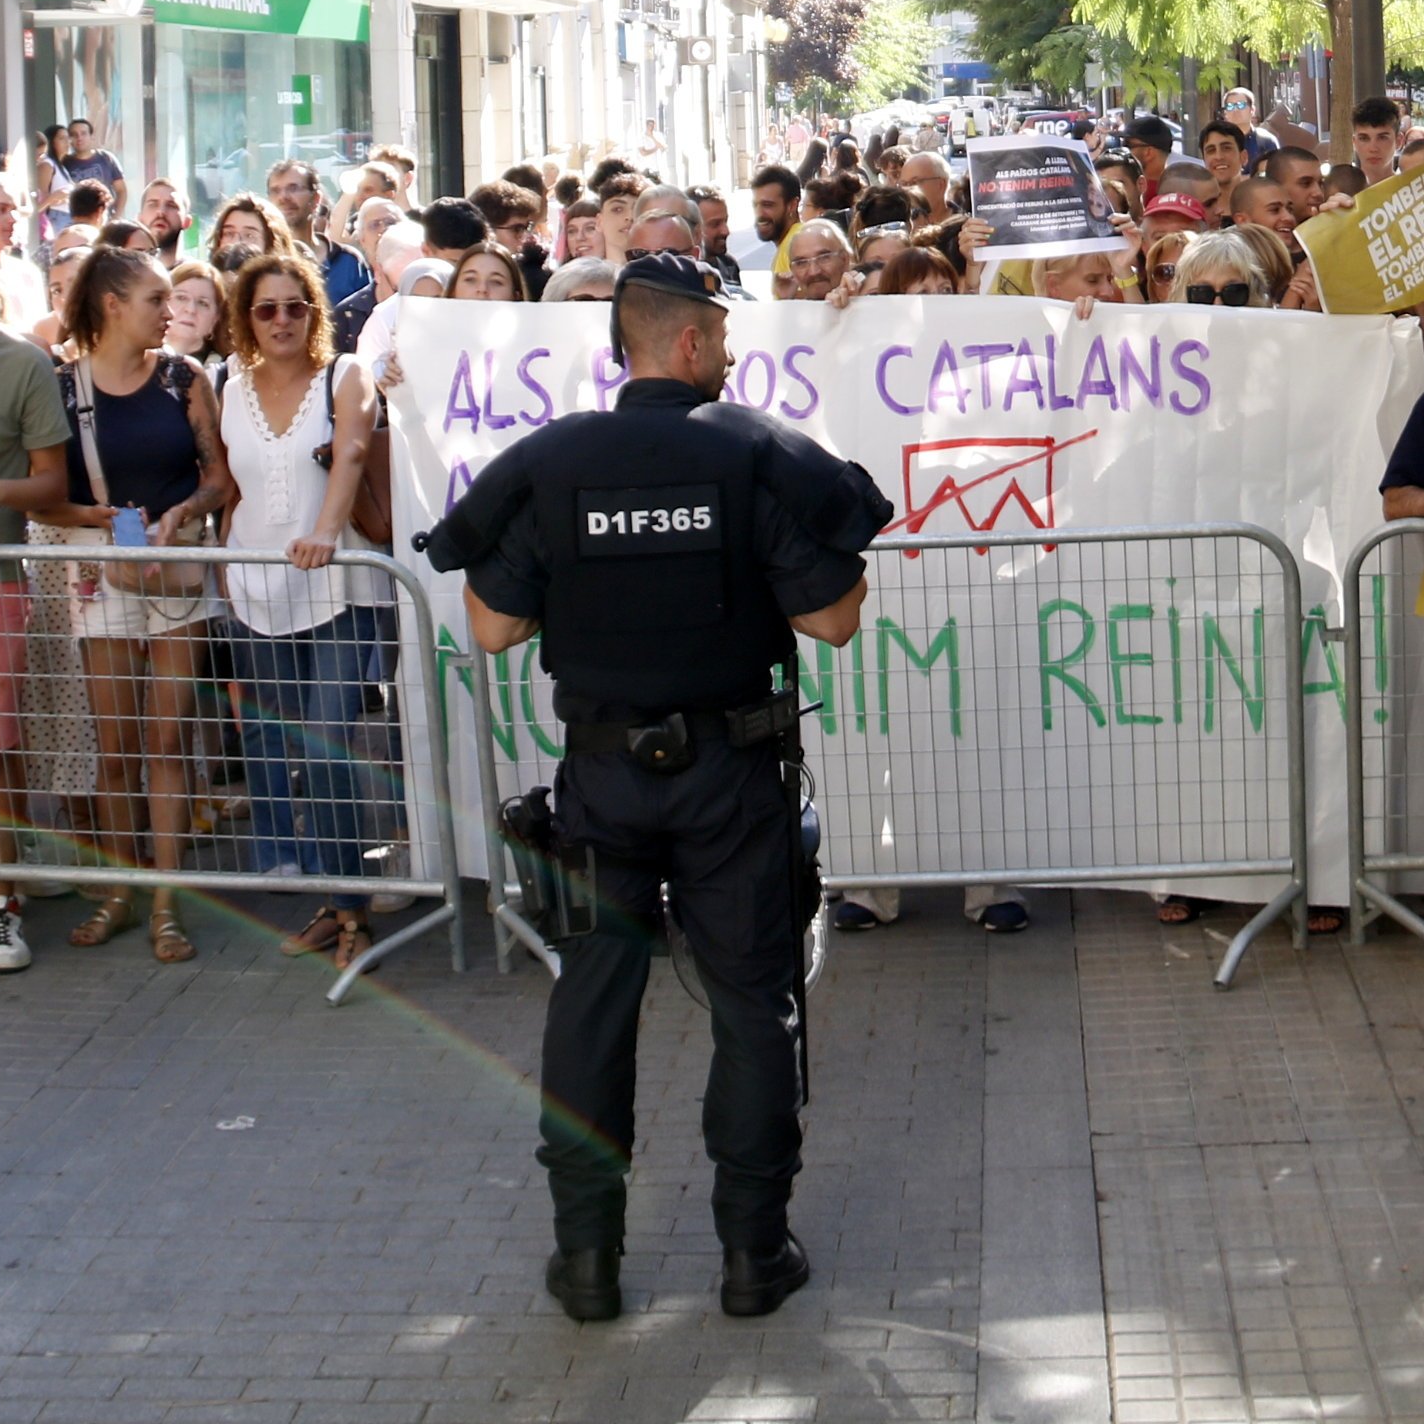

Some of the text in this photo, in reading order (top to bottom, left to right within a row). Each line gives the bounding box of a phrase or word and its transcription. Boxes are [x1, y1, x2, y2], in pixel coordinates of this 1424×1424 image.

[1035, 119, 1069, 136] rne
[995, 166, 1072, 179] ALS PAÏSOS CATALANS
[978, 177, 1074, 193] NO TENIM REINA!
[1367, 233, 1402, 274] EL
[1382, 282, 1404, 304] EL
[443, 334, 1213, 434] ALS POS CATALANS
[587, 506, 712, 536] D1F365
